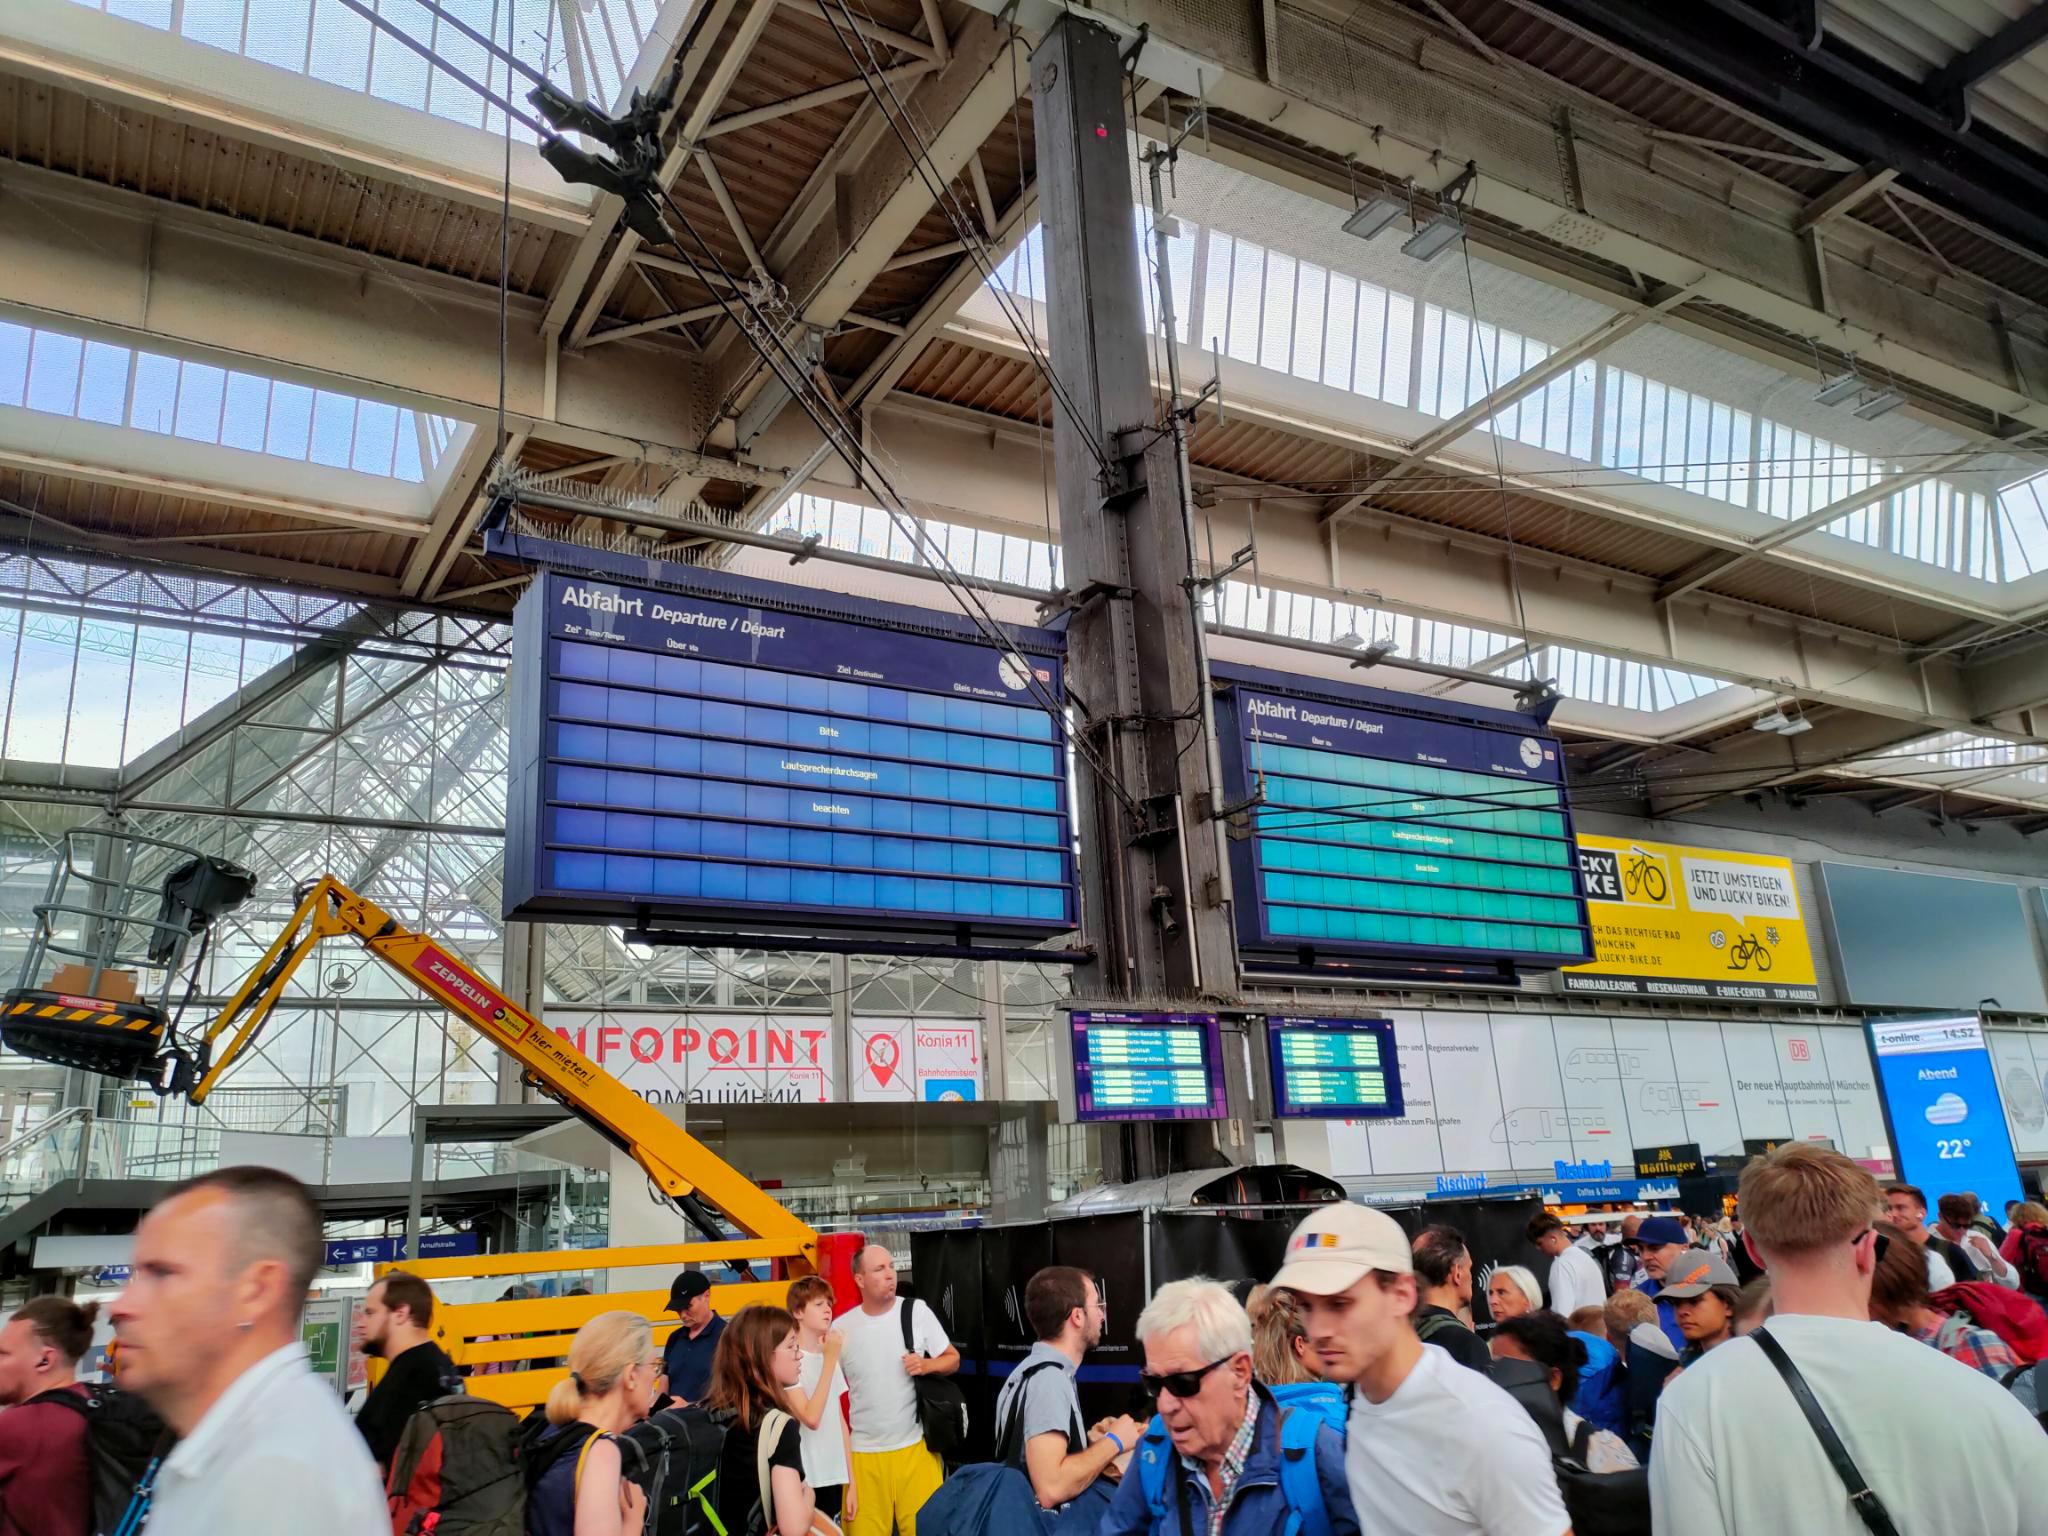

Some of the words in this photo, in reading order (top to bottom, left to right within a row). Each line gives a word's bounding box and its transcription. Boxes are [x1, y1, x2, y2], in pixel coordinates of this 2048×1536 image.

[562, 586, 643, 617] Abfahrt
[651, 605, 727, 630] Departure
[730, 617, 737, 631] /
[741, 620, 785, 638] Départ
[666, 638, 687, 650] Über
[837, 665, 851, 675] Ziel
[1247, 698, 1297, 720] Abfahrt
[1301, 710, 1348, 728] Departure
[1349, 718, 1354, 729] /
[1355, 720, 1384, 734] Départ
[819, 726, 839, 738] Bitte
[781, 760, 878, 780] Lautsprecherdurchsagen
[813, 803, 850, 815] beachten
[1690, 868, 1721, 885] JETZT
[1724, 871, 1782, 891] UMSTEIGEN
[1694, 886, 1717, 902] UND
[1720, 889, 1752, 905] LUCKY
[1758, 892, 1791, 907] BIKEN!
[1606, 925, 1622, 935] DAS
[1625, 928, 1663, 939] RICHTIGE
[1664, 930, 1681, 940] RAD
[430, 961, 491, 1009] ZEPPELIN
[1568, 978, 1637, 992] FAHRRADLEASING
[1647, 982, 1708, 995] RIESENAUSWAHL
[1716, 985, 1766, 998] E-BIKE-CENTER
[1774, 988, 1788, 999] TOP
[1789, 989, 1817, 1000] MARKEN
[917, 1034, 953, 1048] Колія
[955, 1034, 968, 1047] 11
[1942, 1028, 1976, 1039] 14:52
[529, 1031, 553, 1050] hier
[553, 1050, 588, 1078] mieten
[1427, 1044, 1479, 1053] Regionalverkehr
[1789, 1041, 1809, 1059] DB
[810, 1072, 819, 1080] 11
[918, 1069, 978, 1077] Bahnhofsmission
[1918, 1066, 1958, 1080] Abend
[1737, 1080, 1751, 1090] Der
[1753, 1081, 1773, 1090] neue
[1774, 1080, 1835, 1093] Hauptbahnhof
[1837, 1080, 1870, 1090] München
[1936, 1138, 1972, 1159] 22°
[1638, 1161, 1697, 1176] Höflinger
[1436, 1172, 1488, 1192] Rischart
[1576, 1187, 1596, 1197] Coffee
[1601, 1187, 1621, 1196] Snacks
